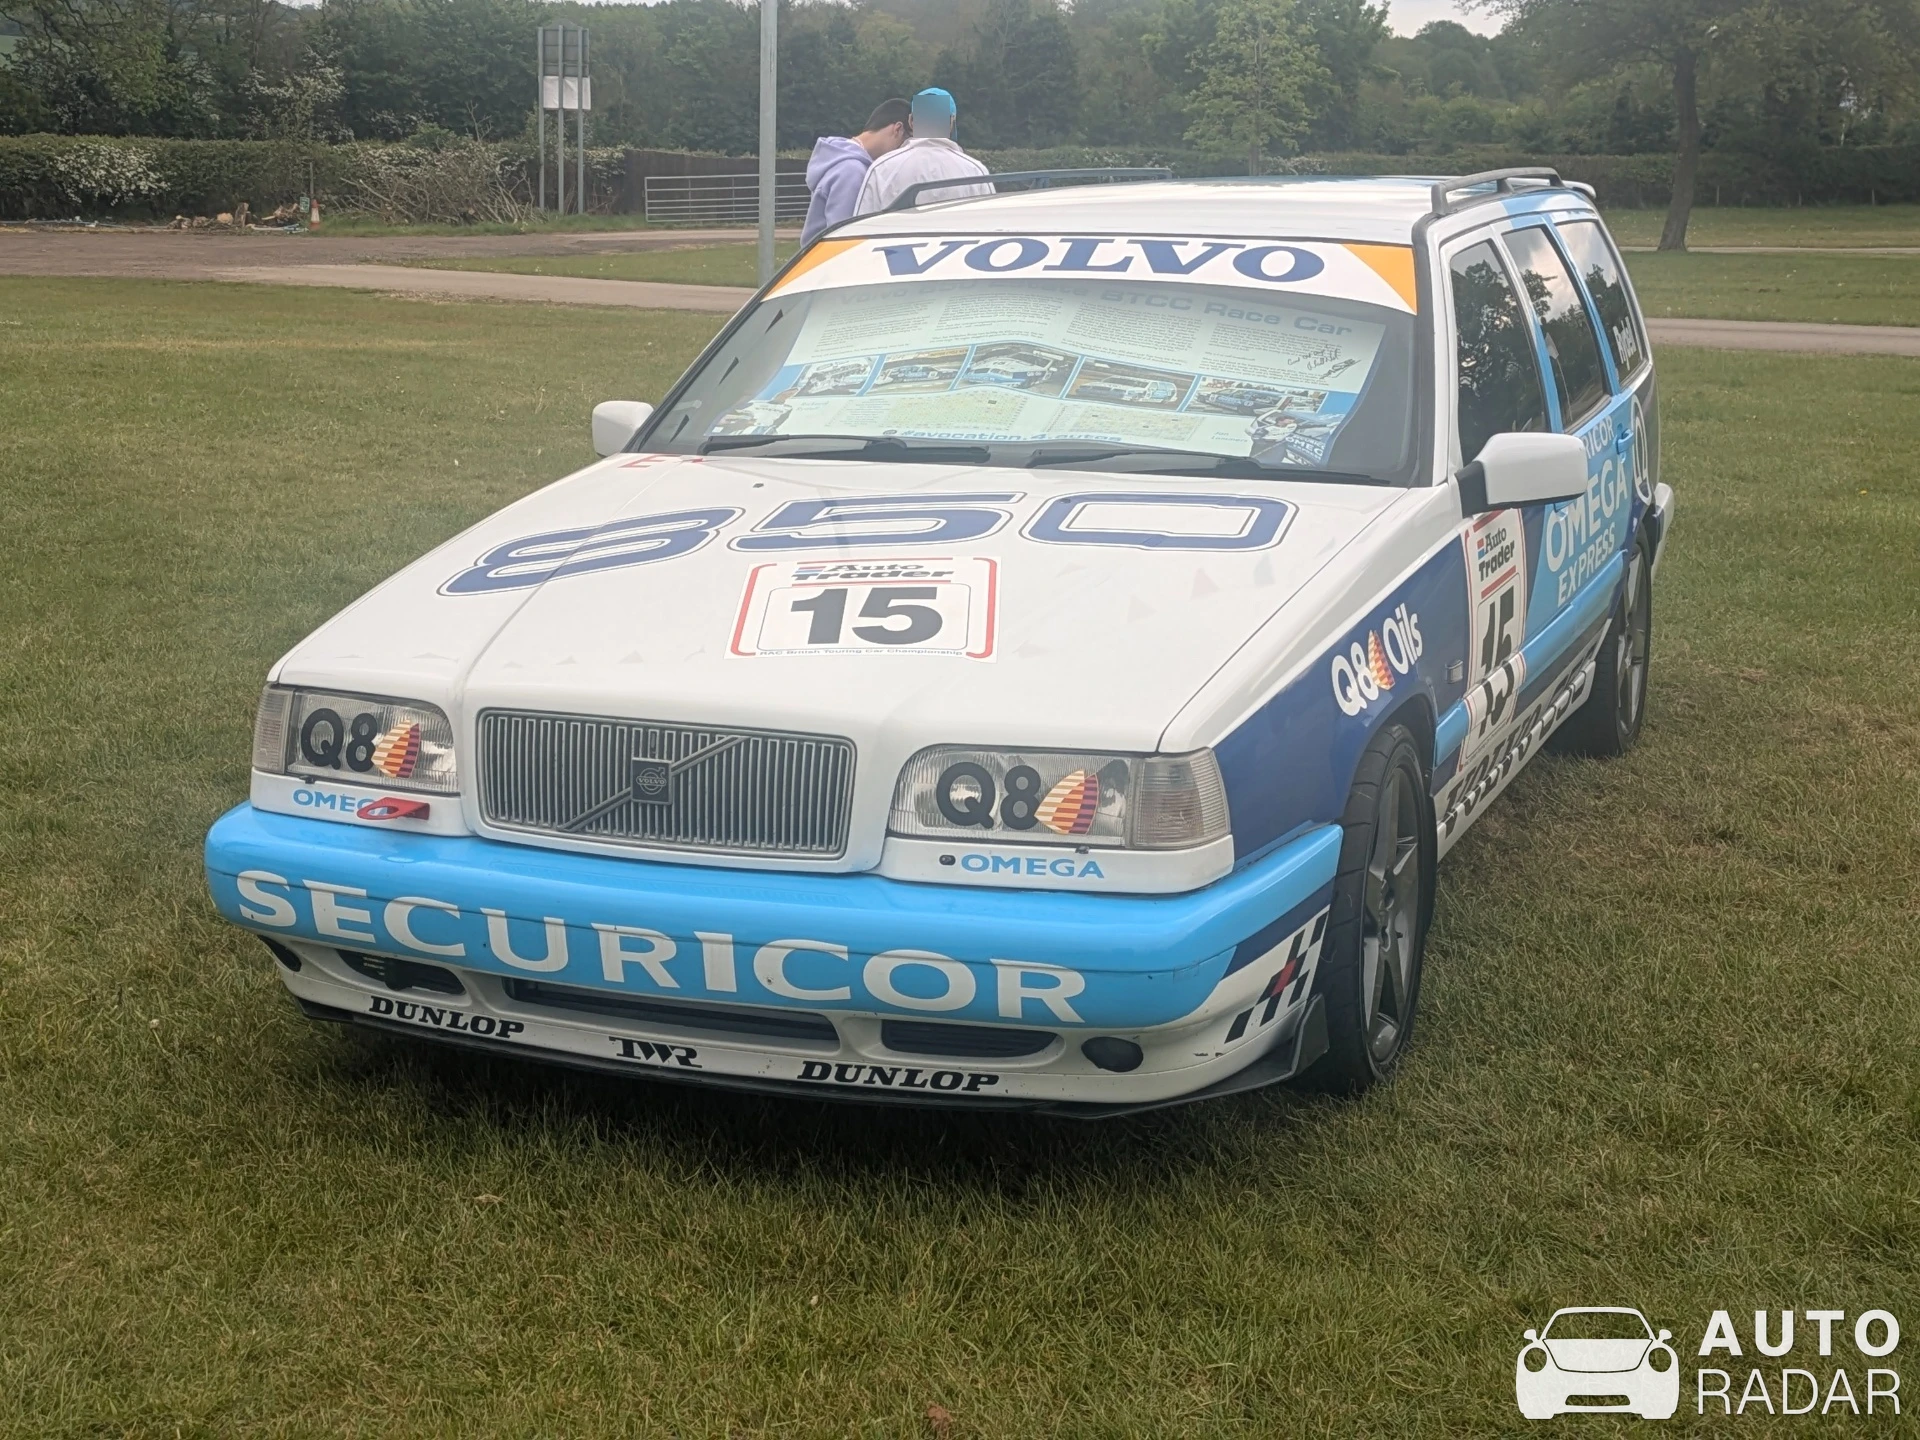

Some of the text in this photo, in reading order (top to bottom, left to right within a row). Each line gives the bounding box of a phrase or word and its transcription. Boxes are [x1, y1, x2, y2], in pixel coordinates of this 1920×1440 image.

[872, 238, 1325, 282] VOLVO
[1102, 288, 1193, 311] BTCC
[1203, 303, 1281, 325] Race
[1293, 315, 1353, 337] Car
[1546, 458, 1628, 573] OMEGA
[438, 491, 1298, 597] 850
[1478, 540, 1516, 582] Trader
[1484, 526, 1508, 553] Auto
[791, 570, 954, 581] Trader
[823, 564, 925, 573] Auto
[1557, 522, 1616, 608] EXPRESS
[790, 586, 944, 646] 15
[886, 647, 963, 657] Championship
[1331, 602, 1424, 717] Q8 Oils
[1478, 585, 1516, 739] 15
[300, 707, 379, 773] Q8
[638, 777, 665, 785] VOLVO
[936, 761, 1042, 830] Q8
[961, 854, 1105, 879] OMEGA
[236, 870, 1087, 1024] SECURICOR
[368, 995, 526, 1040] DUNLOP
[608, 1036, 703, 1069] TWR
[796, 1060, 1001, 1093] DUNLOP
